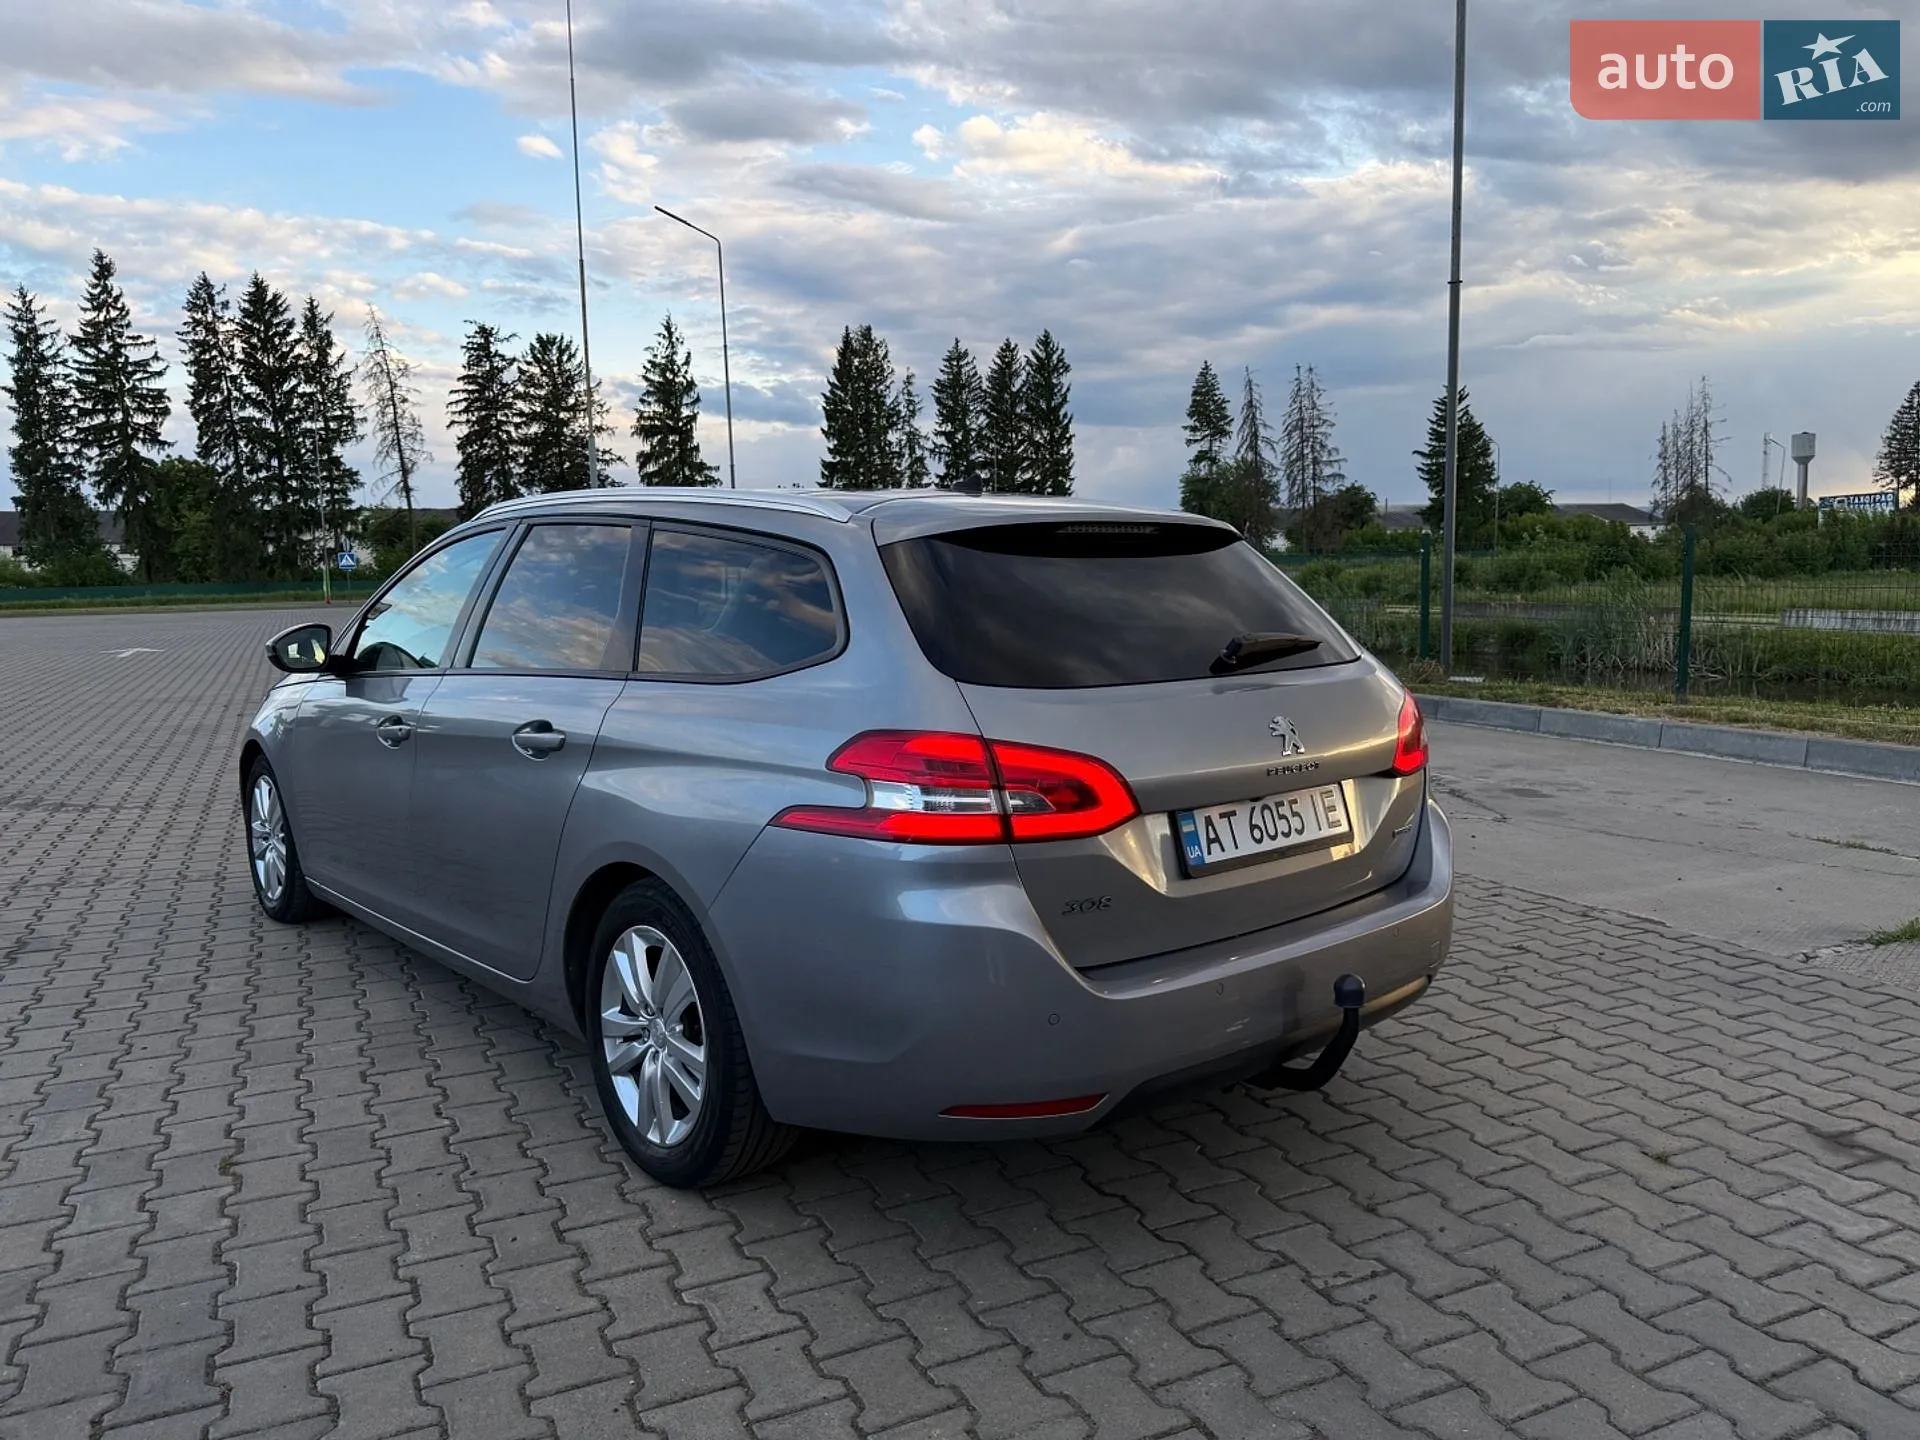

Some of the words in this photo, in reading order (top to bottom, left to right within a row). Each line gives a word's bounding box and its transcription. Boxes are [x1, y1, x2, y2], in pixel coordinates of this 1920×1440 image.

[1203, 810, 1240, 856] AT
[1249, 798, 1305, 845] 6055
[1310, 789, 1343, 832] IE
[1186, 845, 1202, 859] UA
